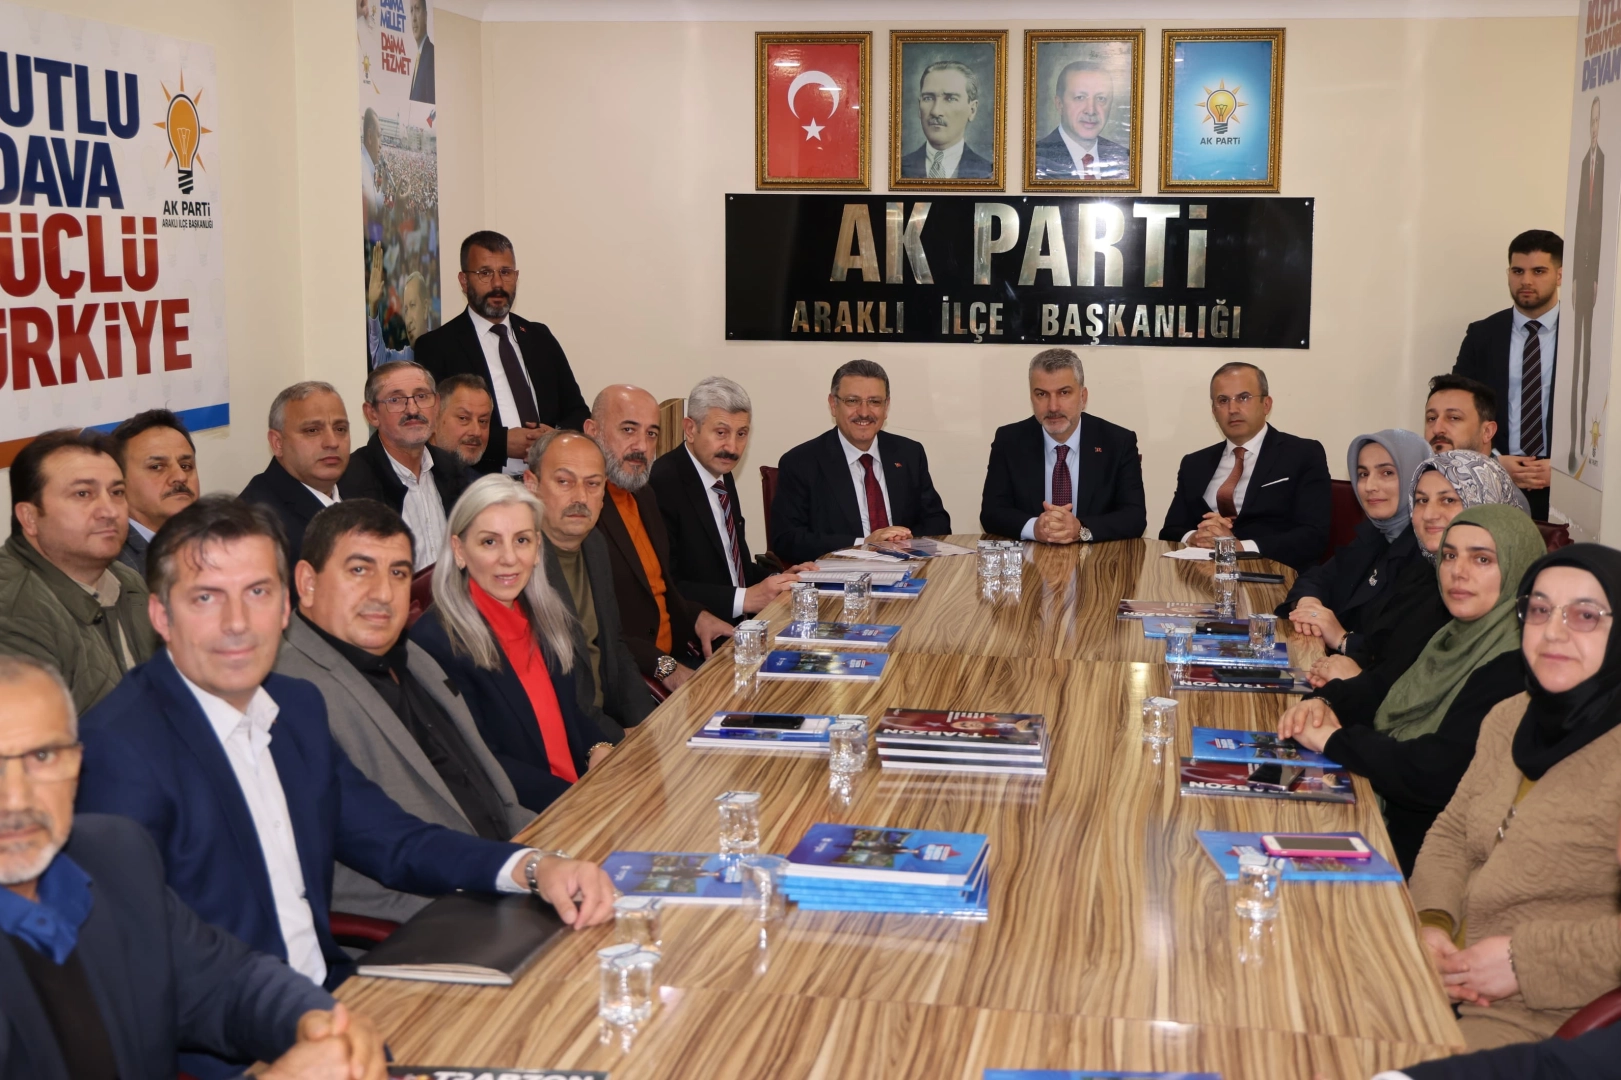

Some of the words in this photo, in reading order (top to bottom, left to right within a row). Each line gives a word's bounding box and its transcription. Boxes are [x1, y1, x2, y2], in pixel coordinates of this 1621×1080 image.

[1200, 137, 1213, 145] AK
[163, 200, 179, 216] AK
[830, 202, 934, 285] AK
[791, 300, 904, 333] ARAKLI
[941, 296, 1004, 343] İLÇE
[1041, 299, 1241, 345] BAŞKANLIĞI
[0, 298, 192, 391] RKiYE
[883, 728, 982, 738] TRABZON
